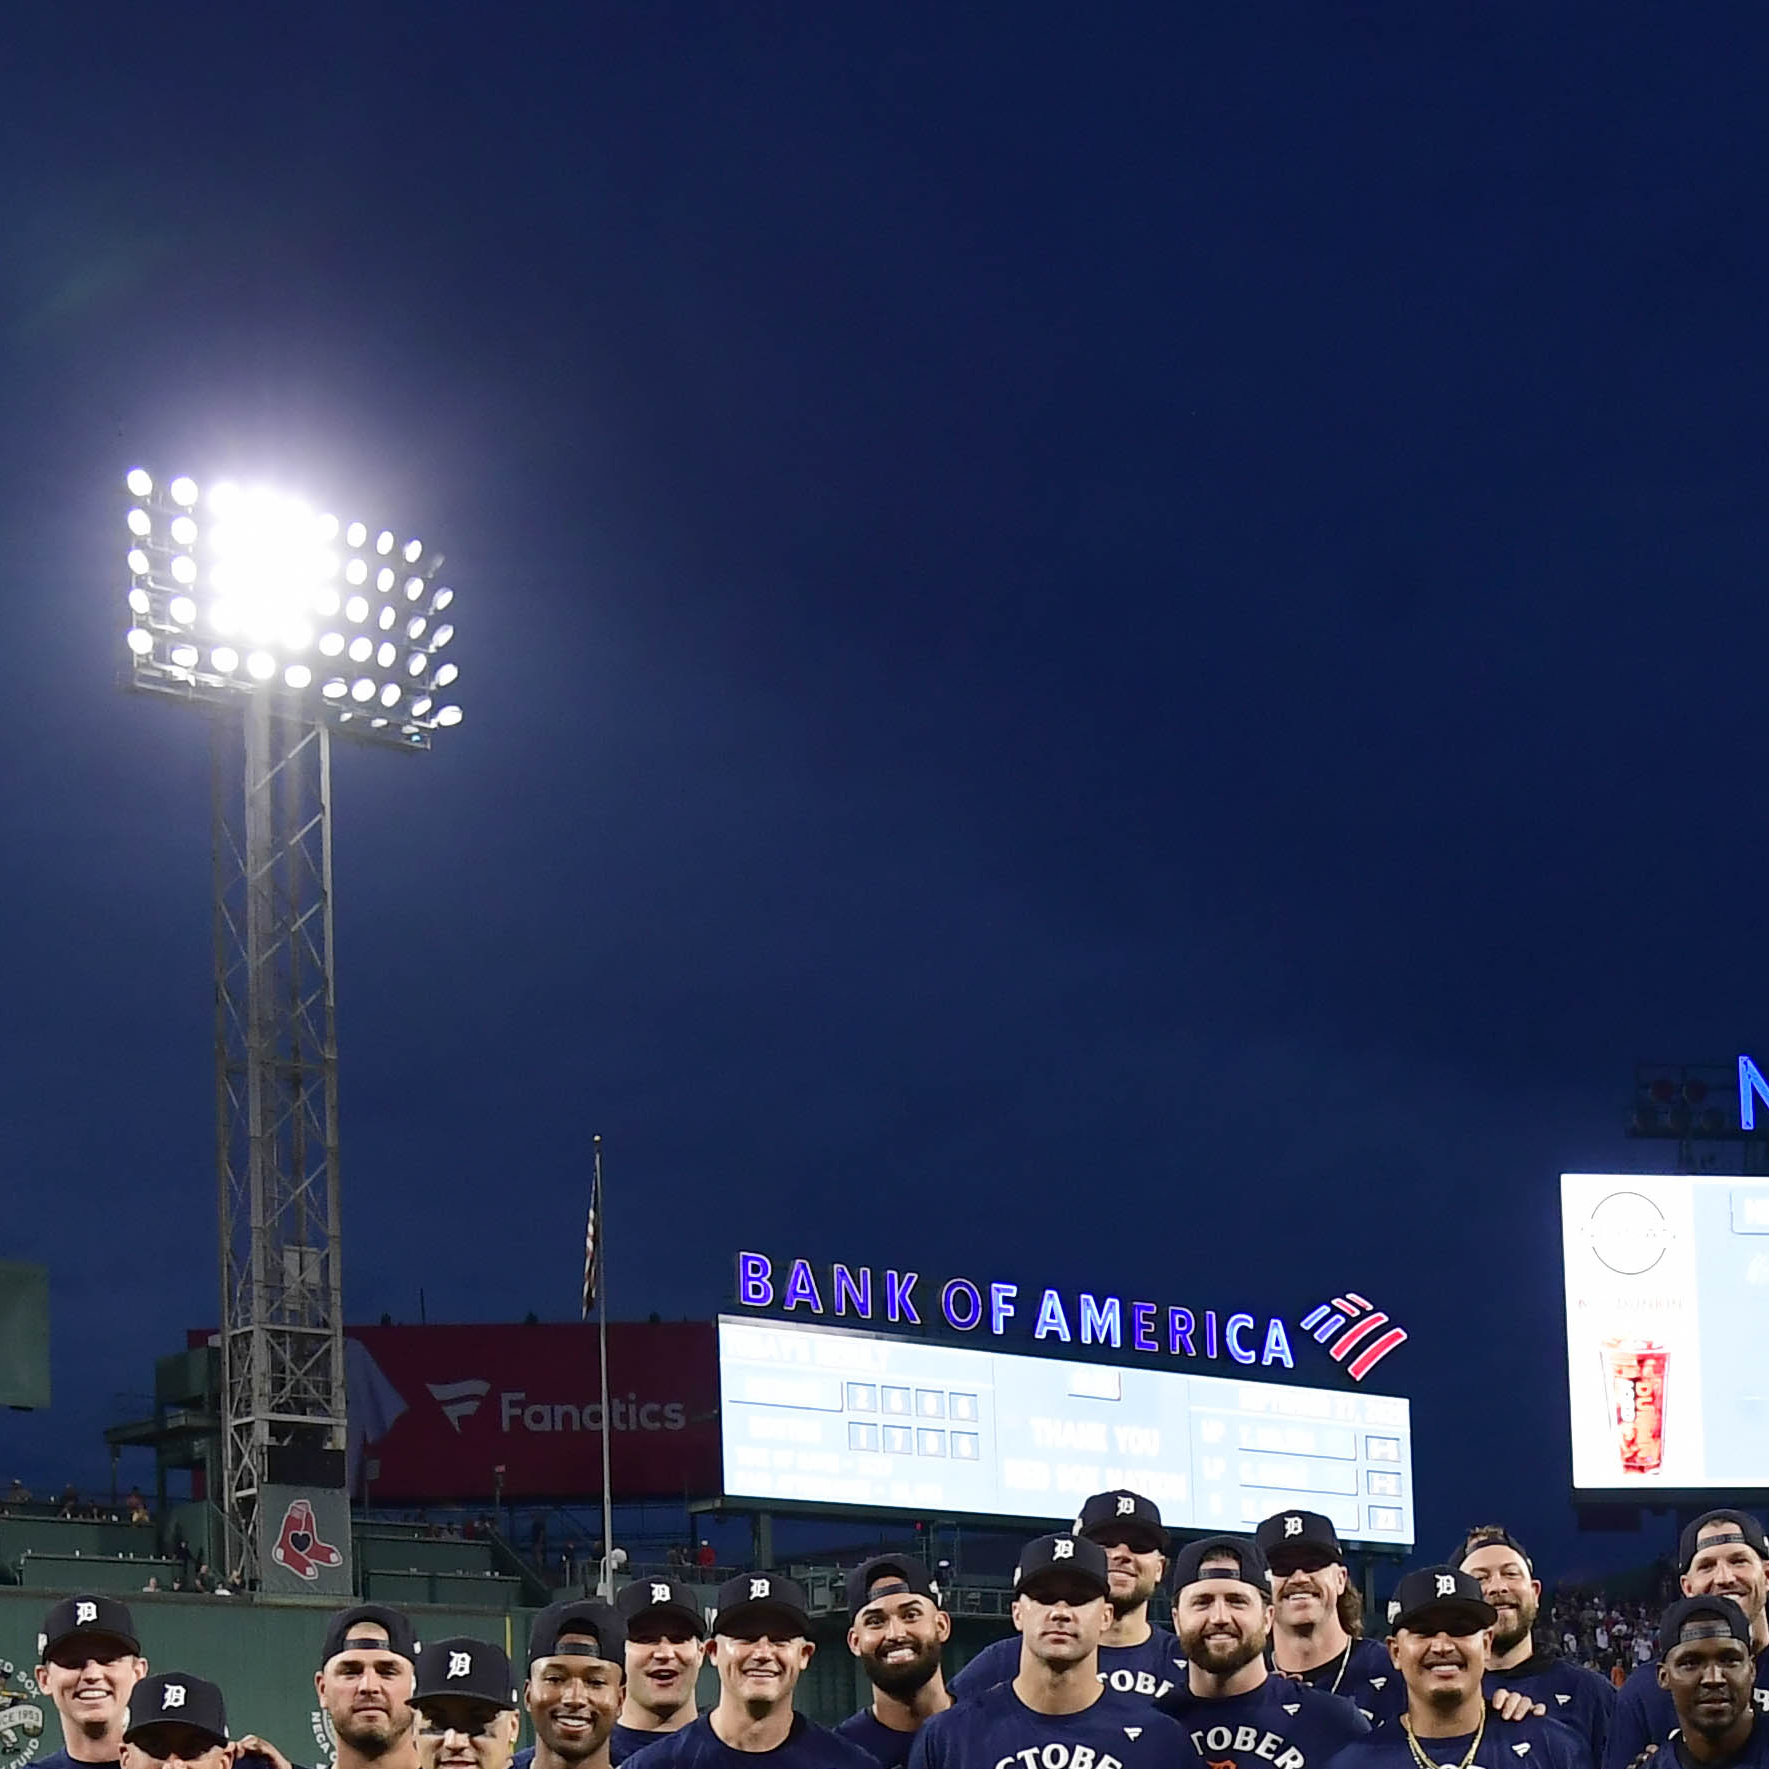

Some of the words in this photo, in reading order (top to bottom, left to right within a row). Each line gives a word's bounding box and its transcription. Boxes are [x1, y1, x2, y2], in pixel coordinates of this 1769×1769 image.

[736, 1250, 923, 1326] BANK
[941, 1276, 1019, 1336] OF
[1034, 1287, 1297, 1371] AMERICA
[498, 1391, 687, 1434] Fanatics
[16, 1671, 41, 1699] SOX
[17, 1709, 40, 1723] 1953
